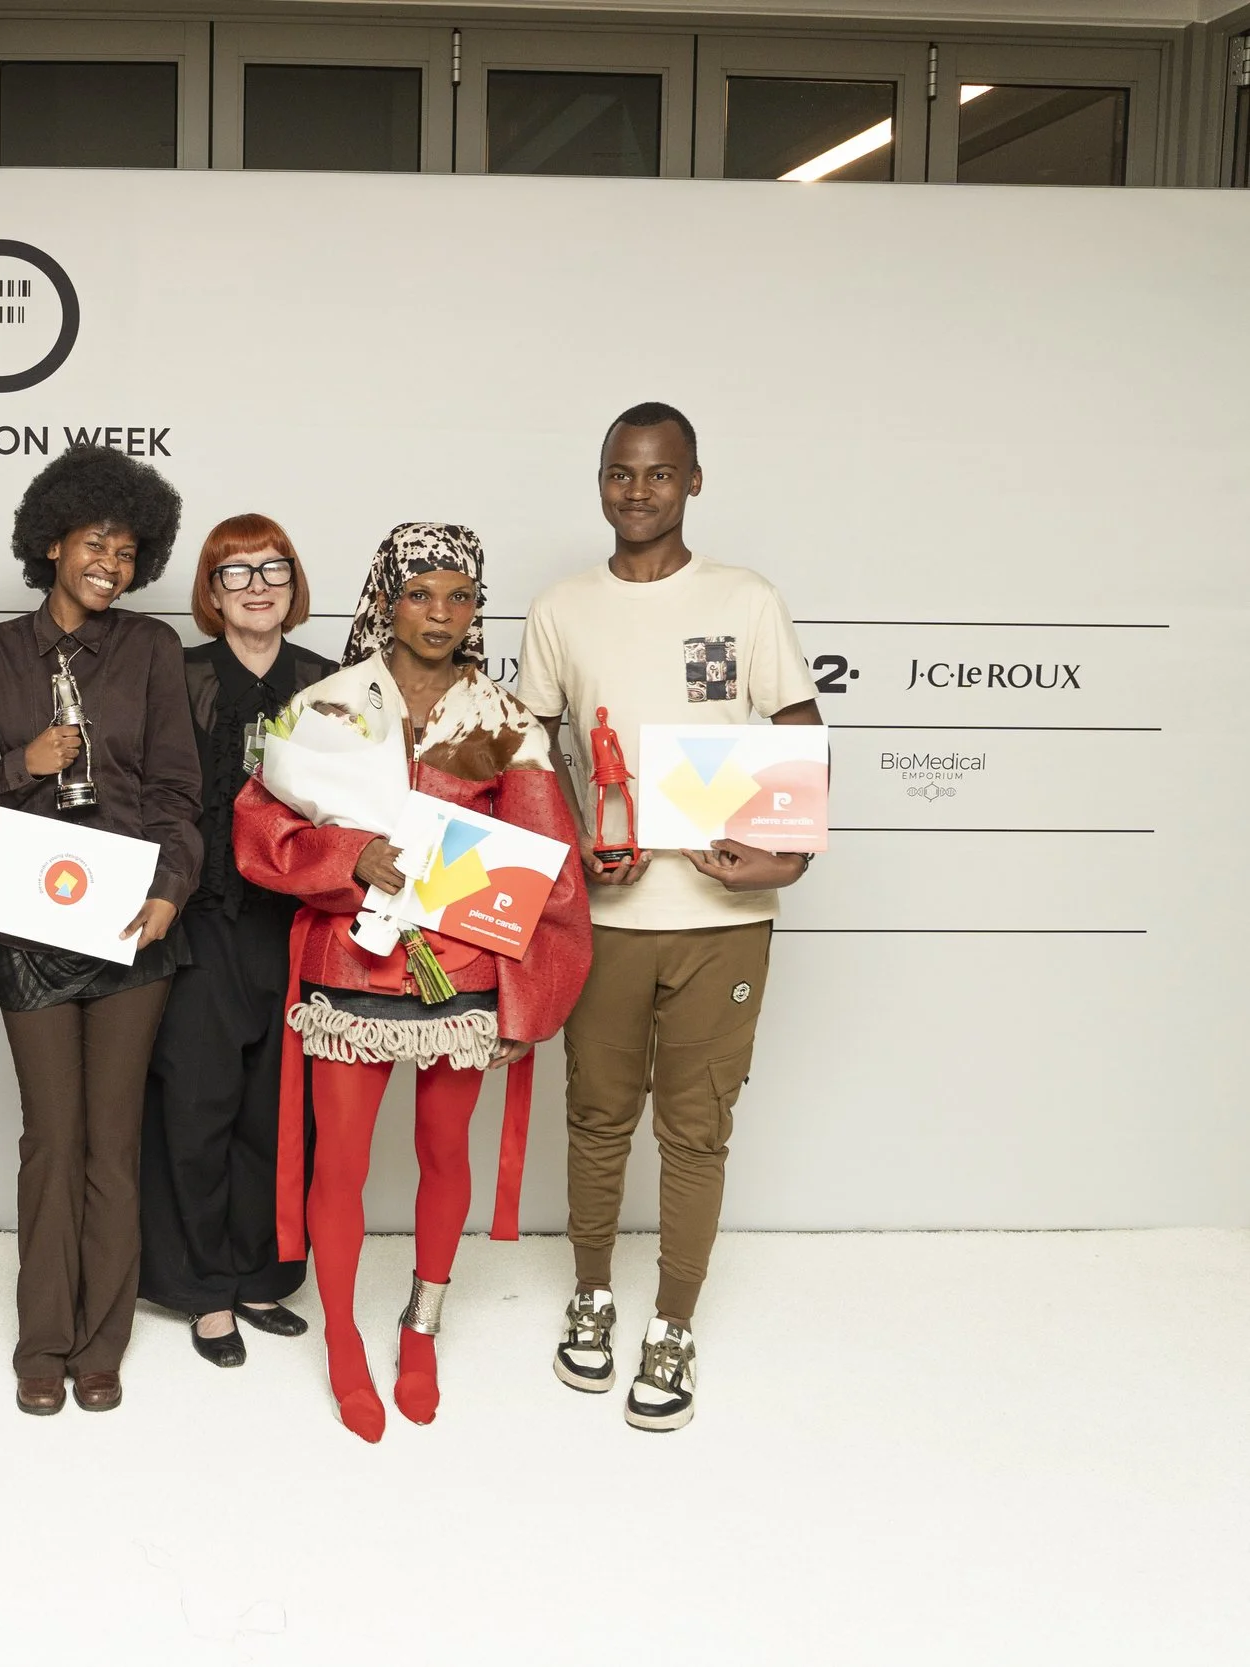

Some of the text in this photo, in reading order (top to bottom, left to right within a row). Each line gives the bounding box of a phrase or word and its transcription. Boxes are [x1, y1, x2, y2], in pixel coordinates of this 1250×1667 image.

[63, 427, 172, 457] WEEK
[880, 752, 986, 771] BioMedical
[901, 771, 963, 781] EMPORIUM
[468, 908, 523, 933] pierre cardin
